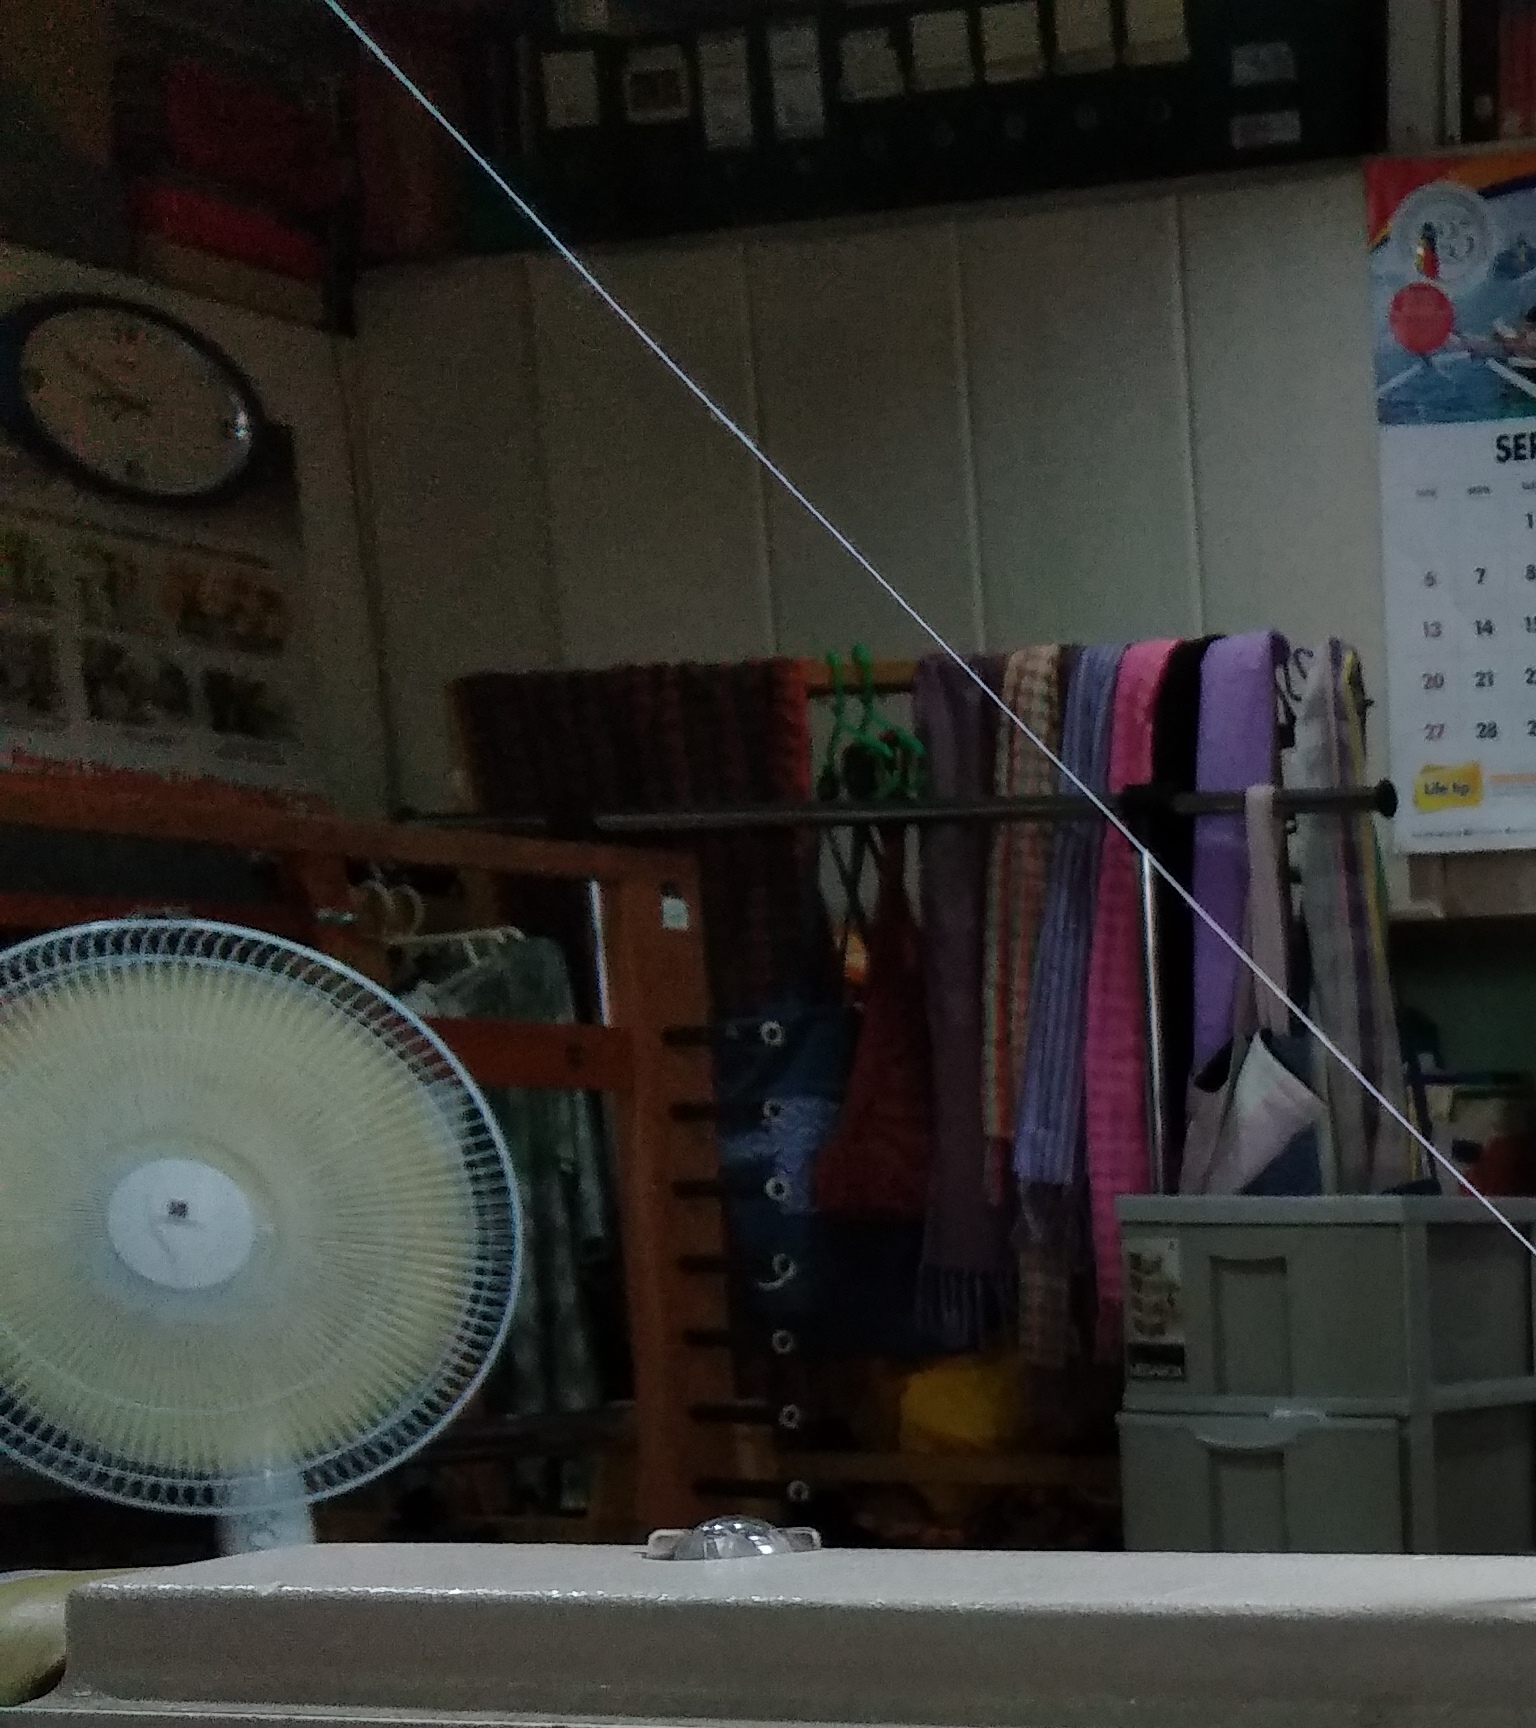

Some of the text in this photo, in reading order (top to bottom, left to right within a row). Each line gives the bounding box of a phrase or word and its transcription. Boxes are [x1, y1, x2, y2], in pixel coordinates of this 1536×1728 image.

[1526, 513, 1533, 528] 1
[1425, 572, 1436, 587] 6
[1476, 568, 1485, 584] 7
[1526, 565, 1536, 580] 8
[1424, 622, 1442, 638] 13
[1476, 620, 1493, 635] 14
[1423, 674, 1444, 690] 20
[1476, 671, 1493, 687] 21
[1425, 724, 1445, 740] 27
[1477, 723, 1497, 738] 28
